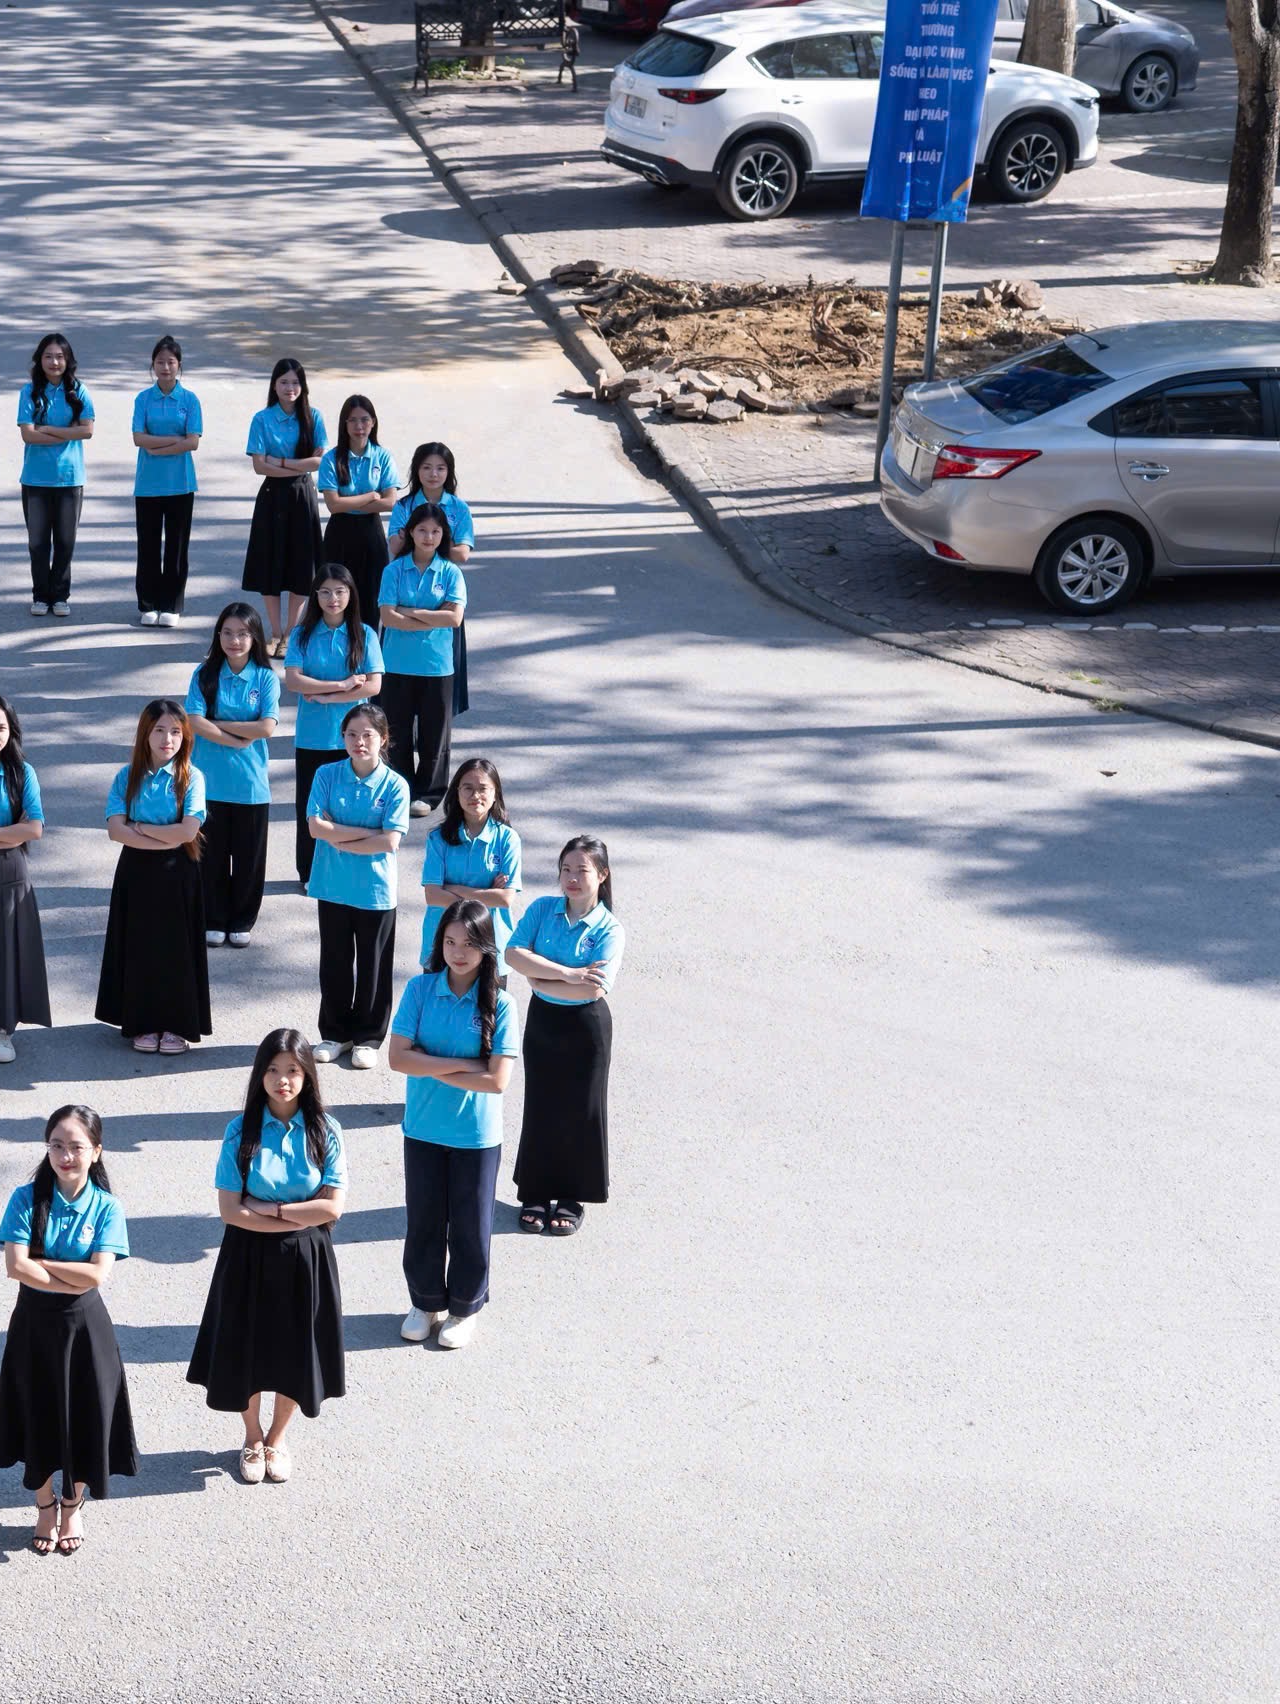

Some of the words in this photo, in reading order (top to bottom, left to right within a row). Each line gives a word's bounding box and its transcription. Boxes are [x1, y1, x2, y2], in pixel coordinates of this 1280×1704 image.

[904, 45, 922, 60] ĐẠI
[940, 46, 965, 59] VINH
[889, 62, 918, 79] SỐNG
[927, 64, 949, 79] LÀM
[951, 66, 974, 83] VIỆC
[920, 107, 949, 121] PHÁP
[917, 149, 943, 165] LUẬT
